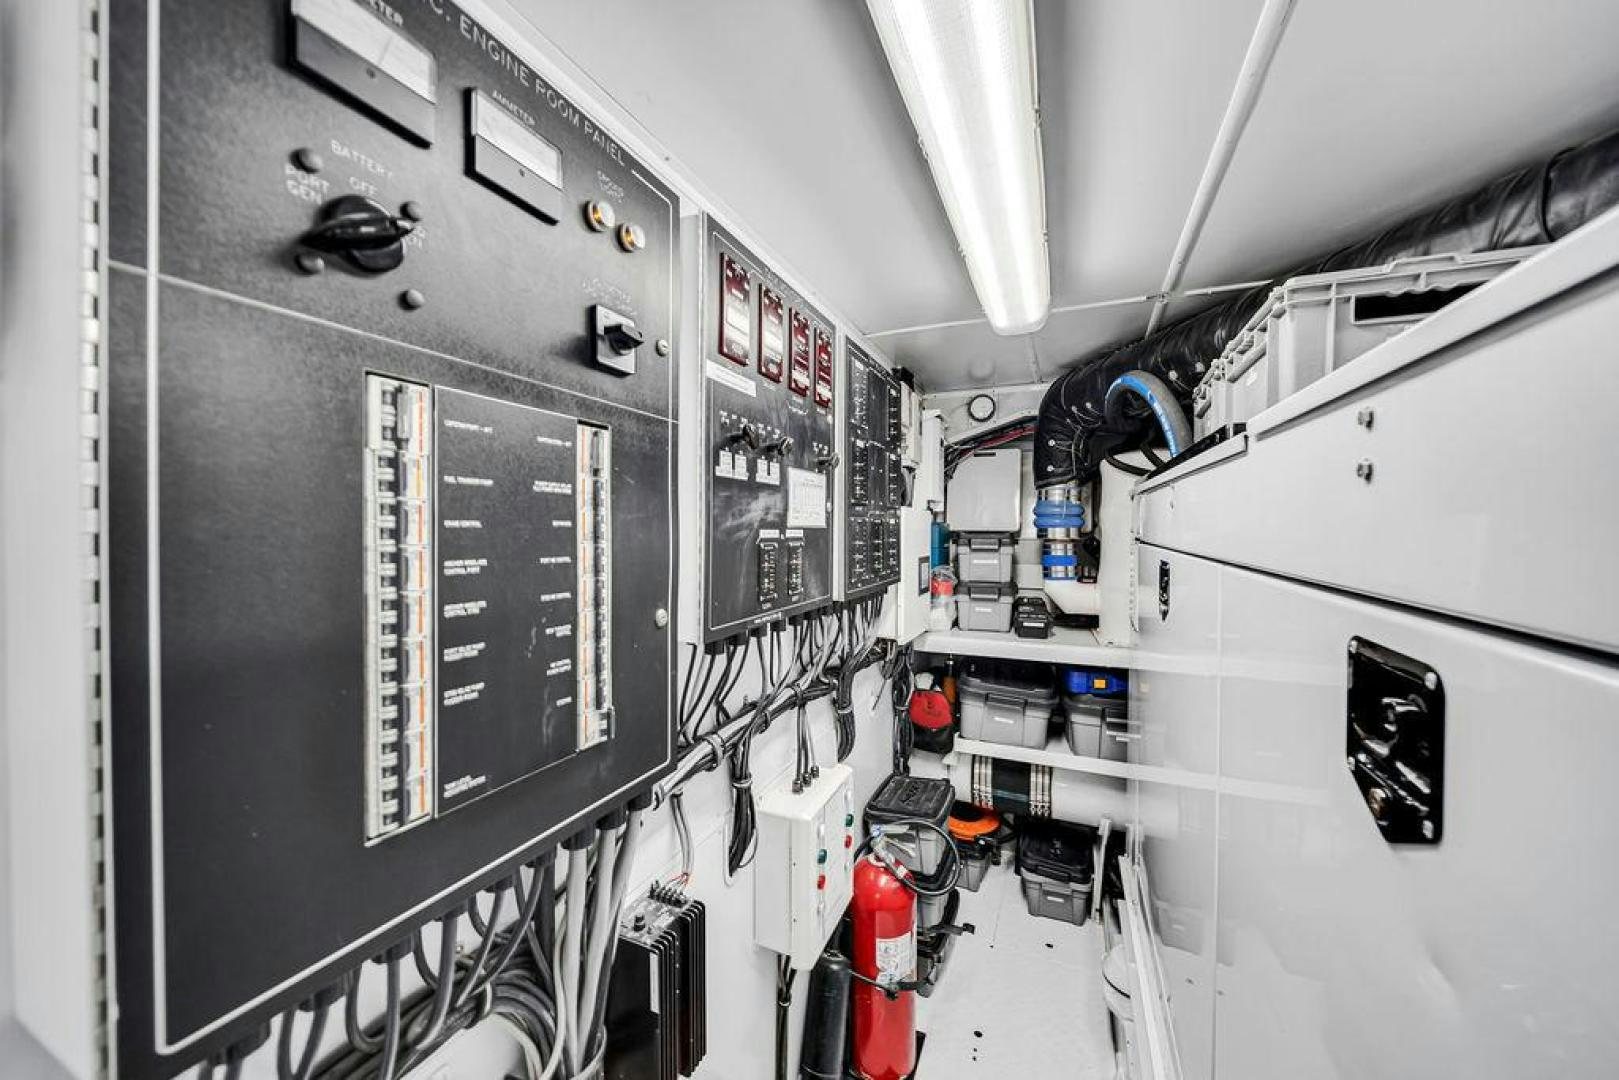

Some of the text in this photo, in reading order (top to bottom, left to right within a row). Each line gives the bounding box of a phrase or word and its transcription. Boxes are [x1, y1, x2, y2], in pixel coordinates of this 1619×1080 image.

[460, 14, 530, 88] ENGINE
[535, 78, 580, 128] ROOM
[584, 120, 625, 167] PANEL
[330, 138, 393, 178] BATTERY
[348, 176, 378, 198] OFF
